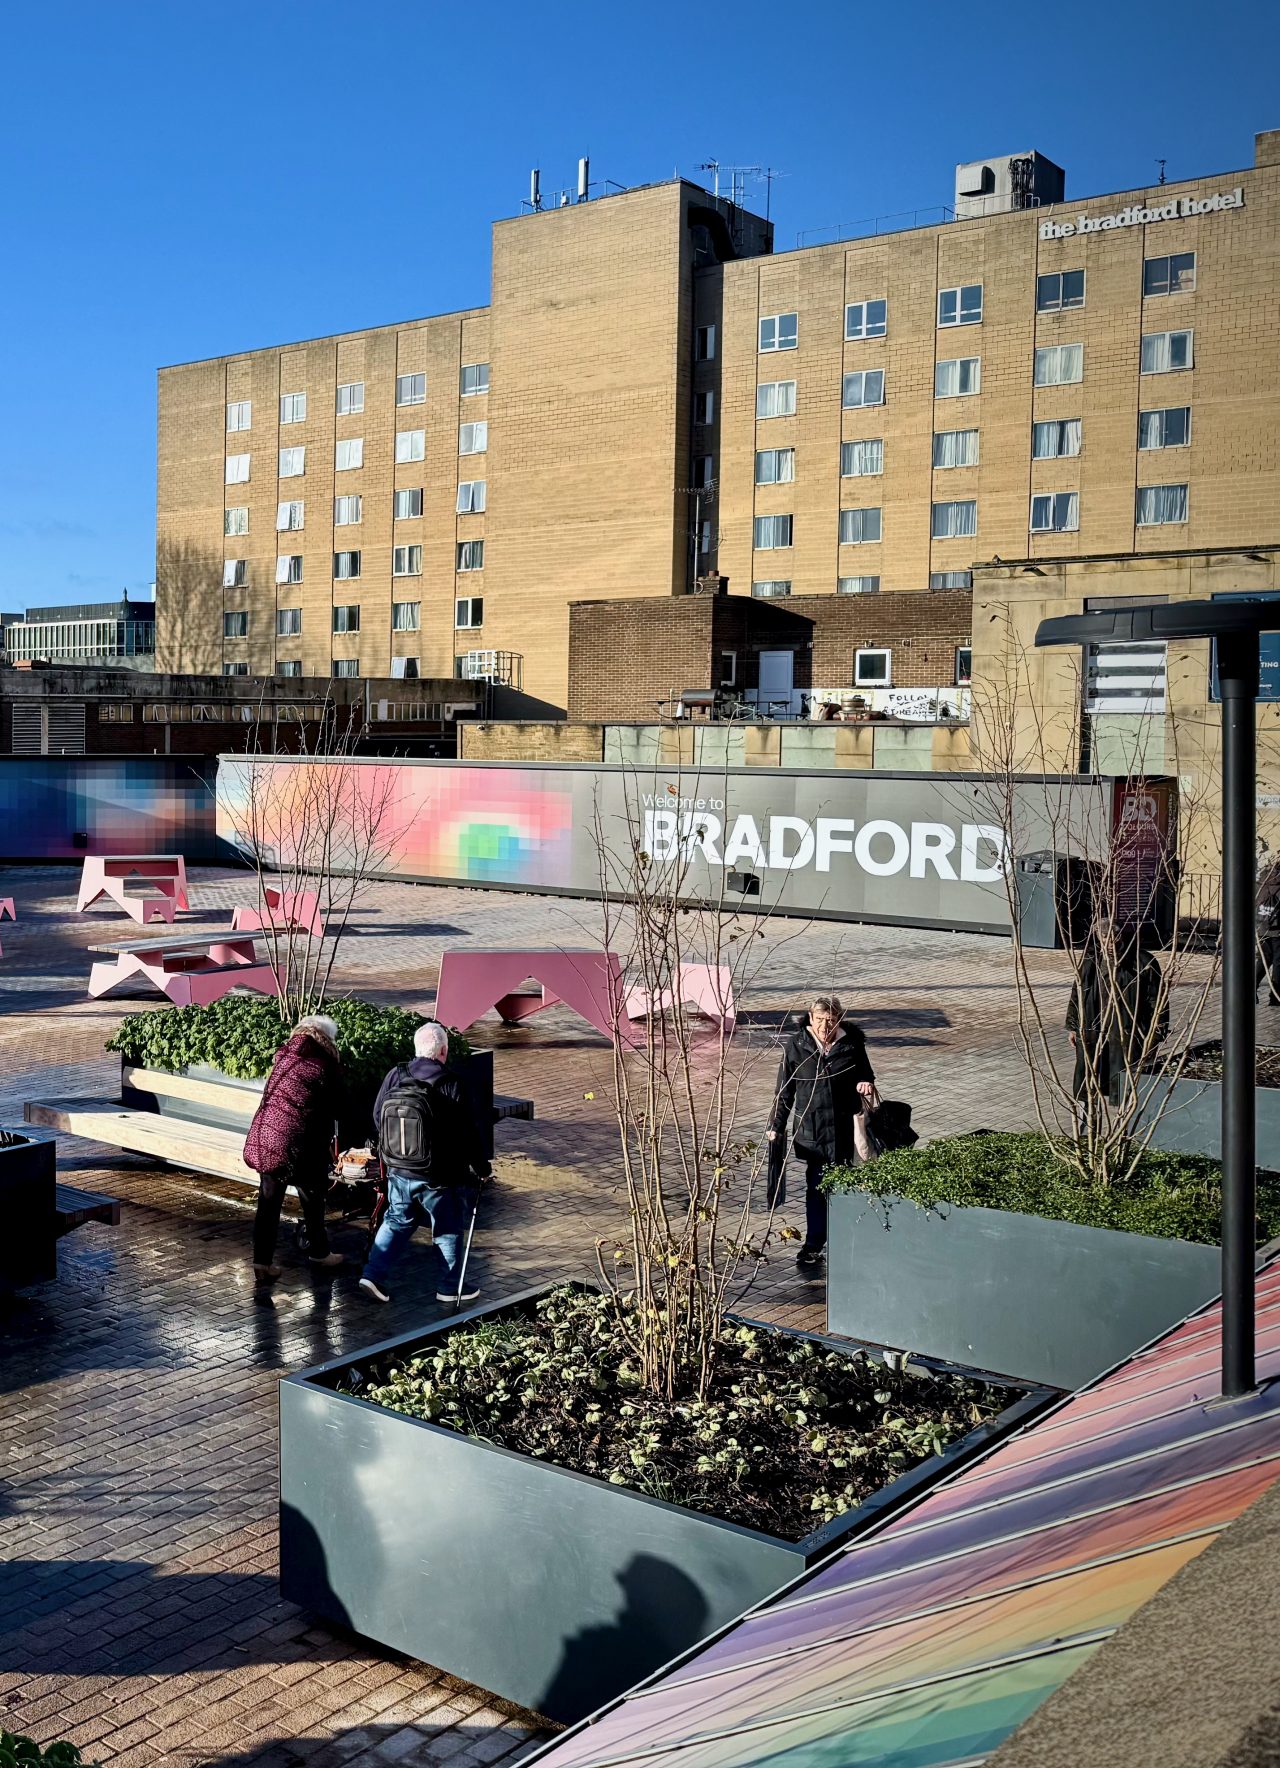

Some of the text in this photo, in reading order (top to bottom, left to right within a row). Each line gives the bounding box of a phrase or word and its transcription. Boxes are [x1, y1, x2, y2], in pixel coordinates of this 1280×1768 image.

[1039, 187, 1245, 240] the bradford hotel
[641, 793, 724, 810] Welcome to
[644, 810, 1012, 882] BRADFORD
